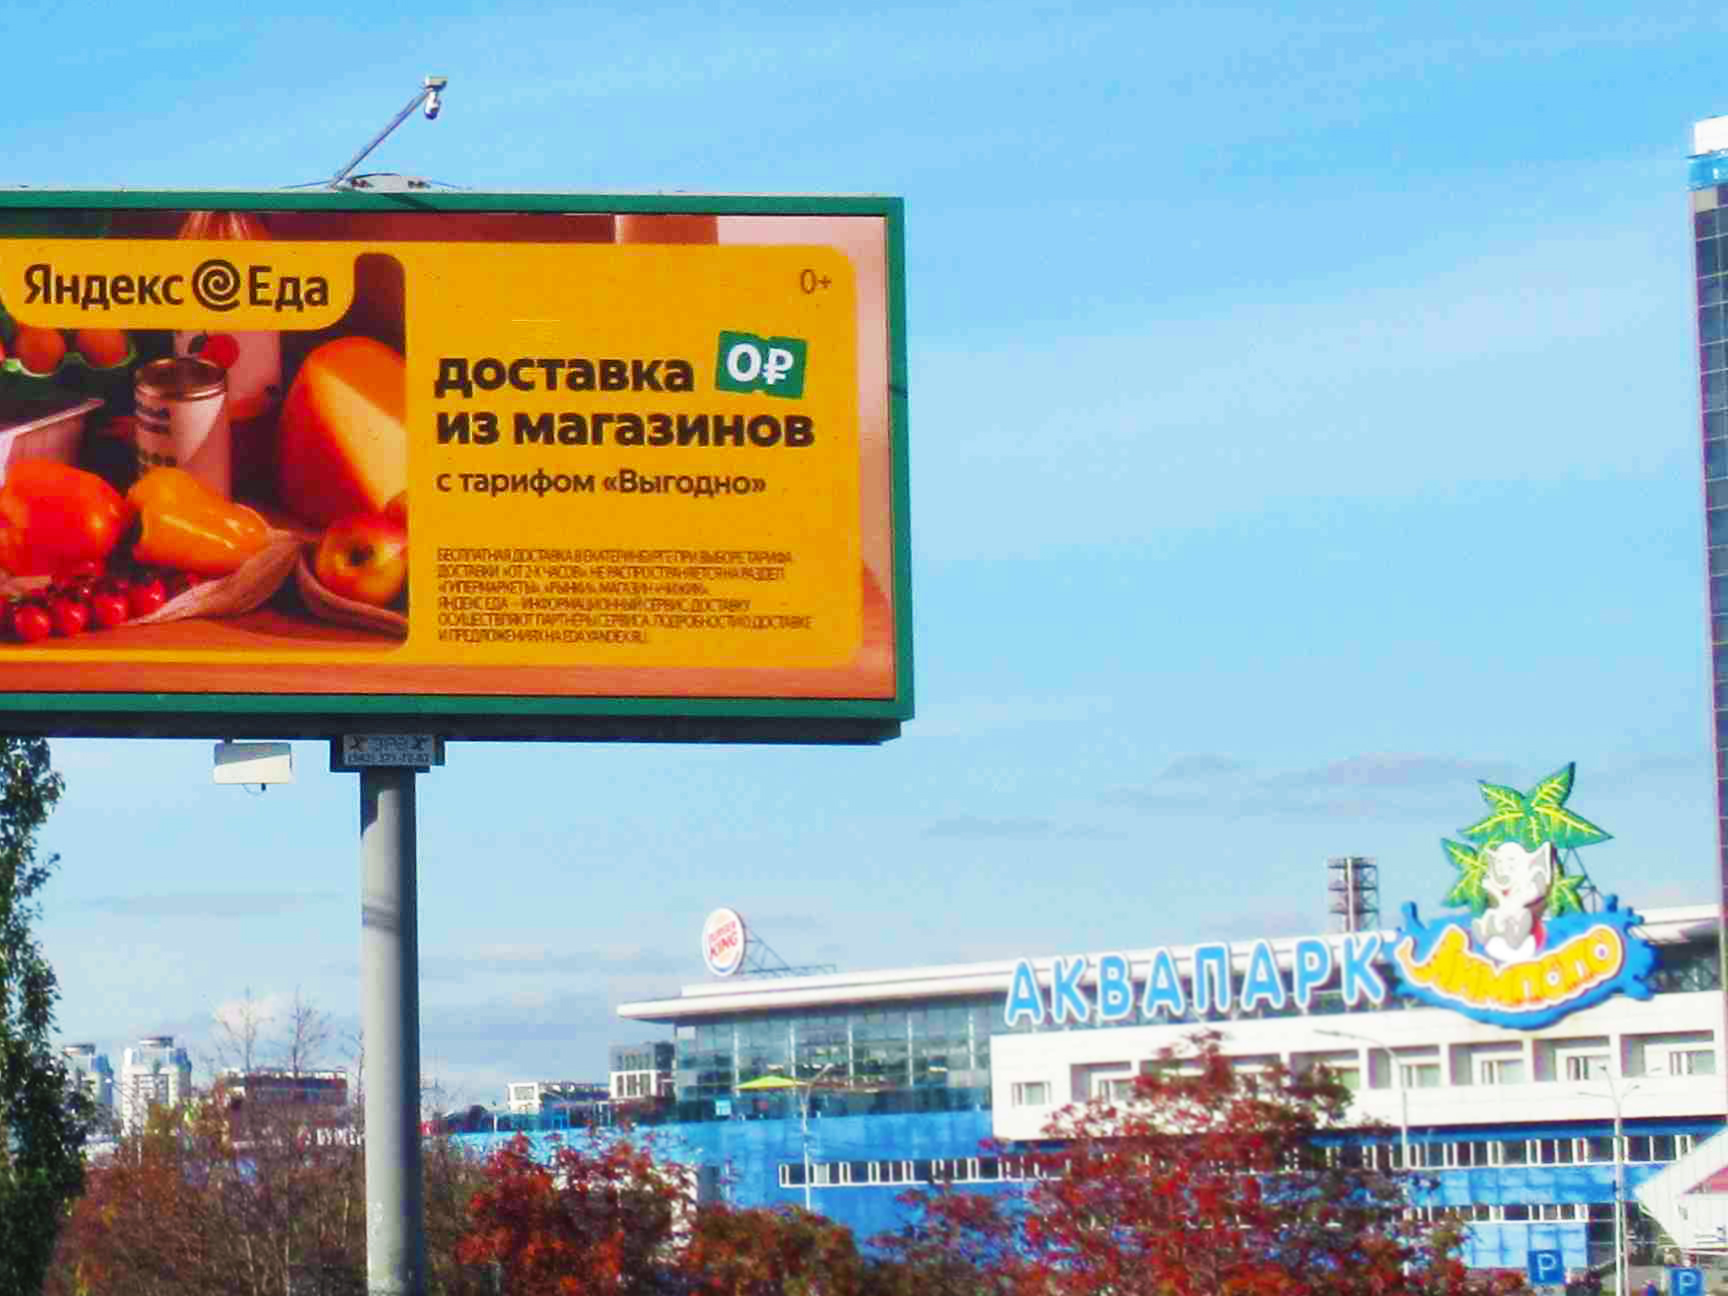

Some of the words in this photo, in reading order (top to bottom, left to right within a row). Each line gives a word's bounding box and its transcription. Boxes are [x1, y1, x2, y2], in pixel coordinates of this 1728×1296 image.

[23, 263, 185, 311] Яндекс
[248, 264, 330, 312] Еда
[799, 268, 833, 295] 0+
[433, 357, 695, 399] доставка
[436, 411, 500, 445] из
[512, 412, 816, 448] магазинов
[436, 472, 451, 493] с
[458, 468, 595, 498] тарифом
[604, 469, 767, 498] «Выгодно»
[513, 547, 572, 563] ДОСТАВКА
[1004, 933, 1386, 1027] АКВАПАРК
